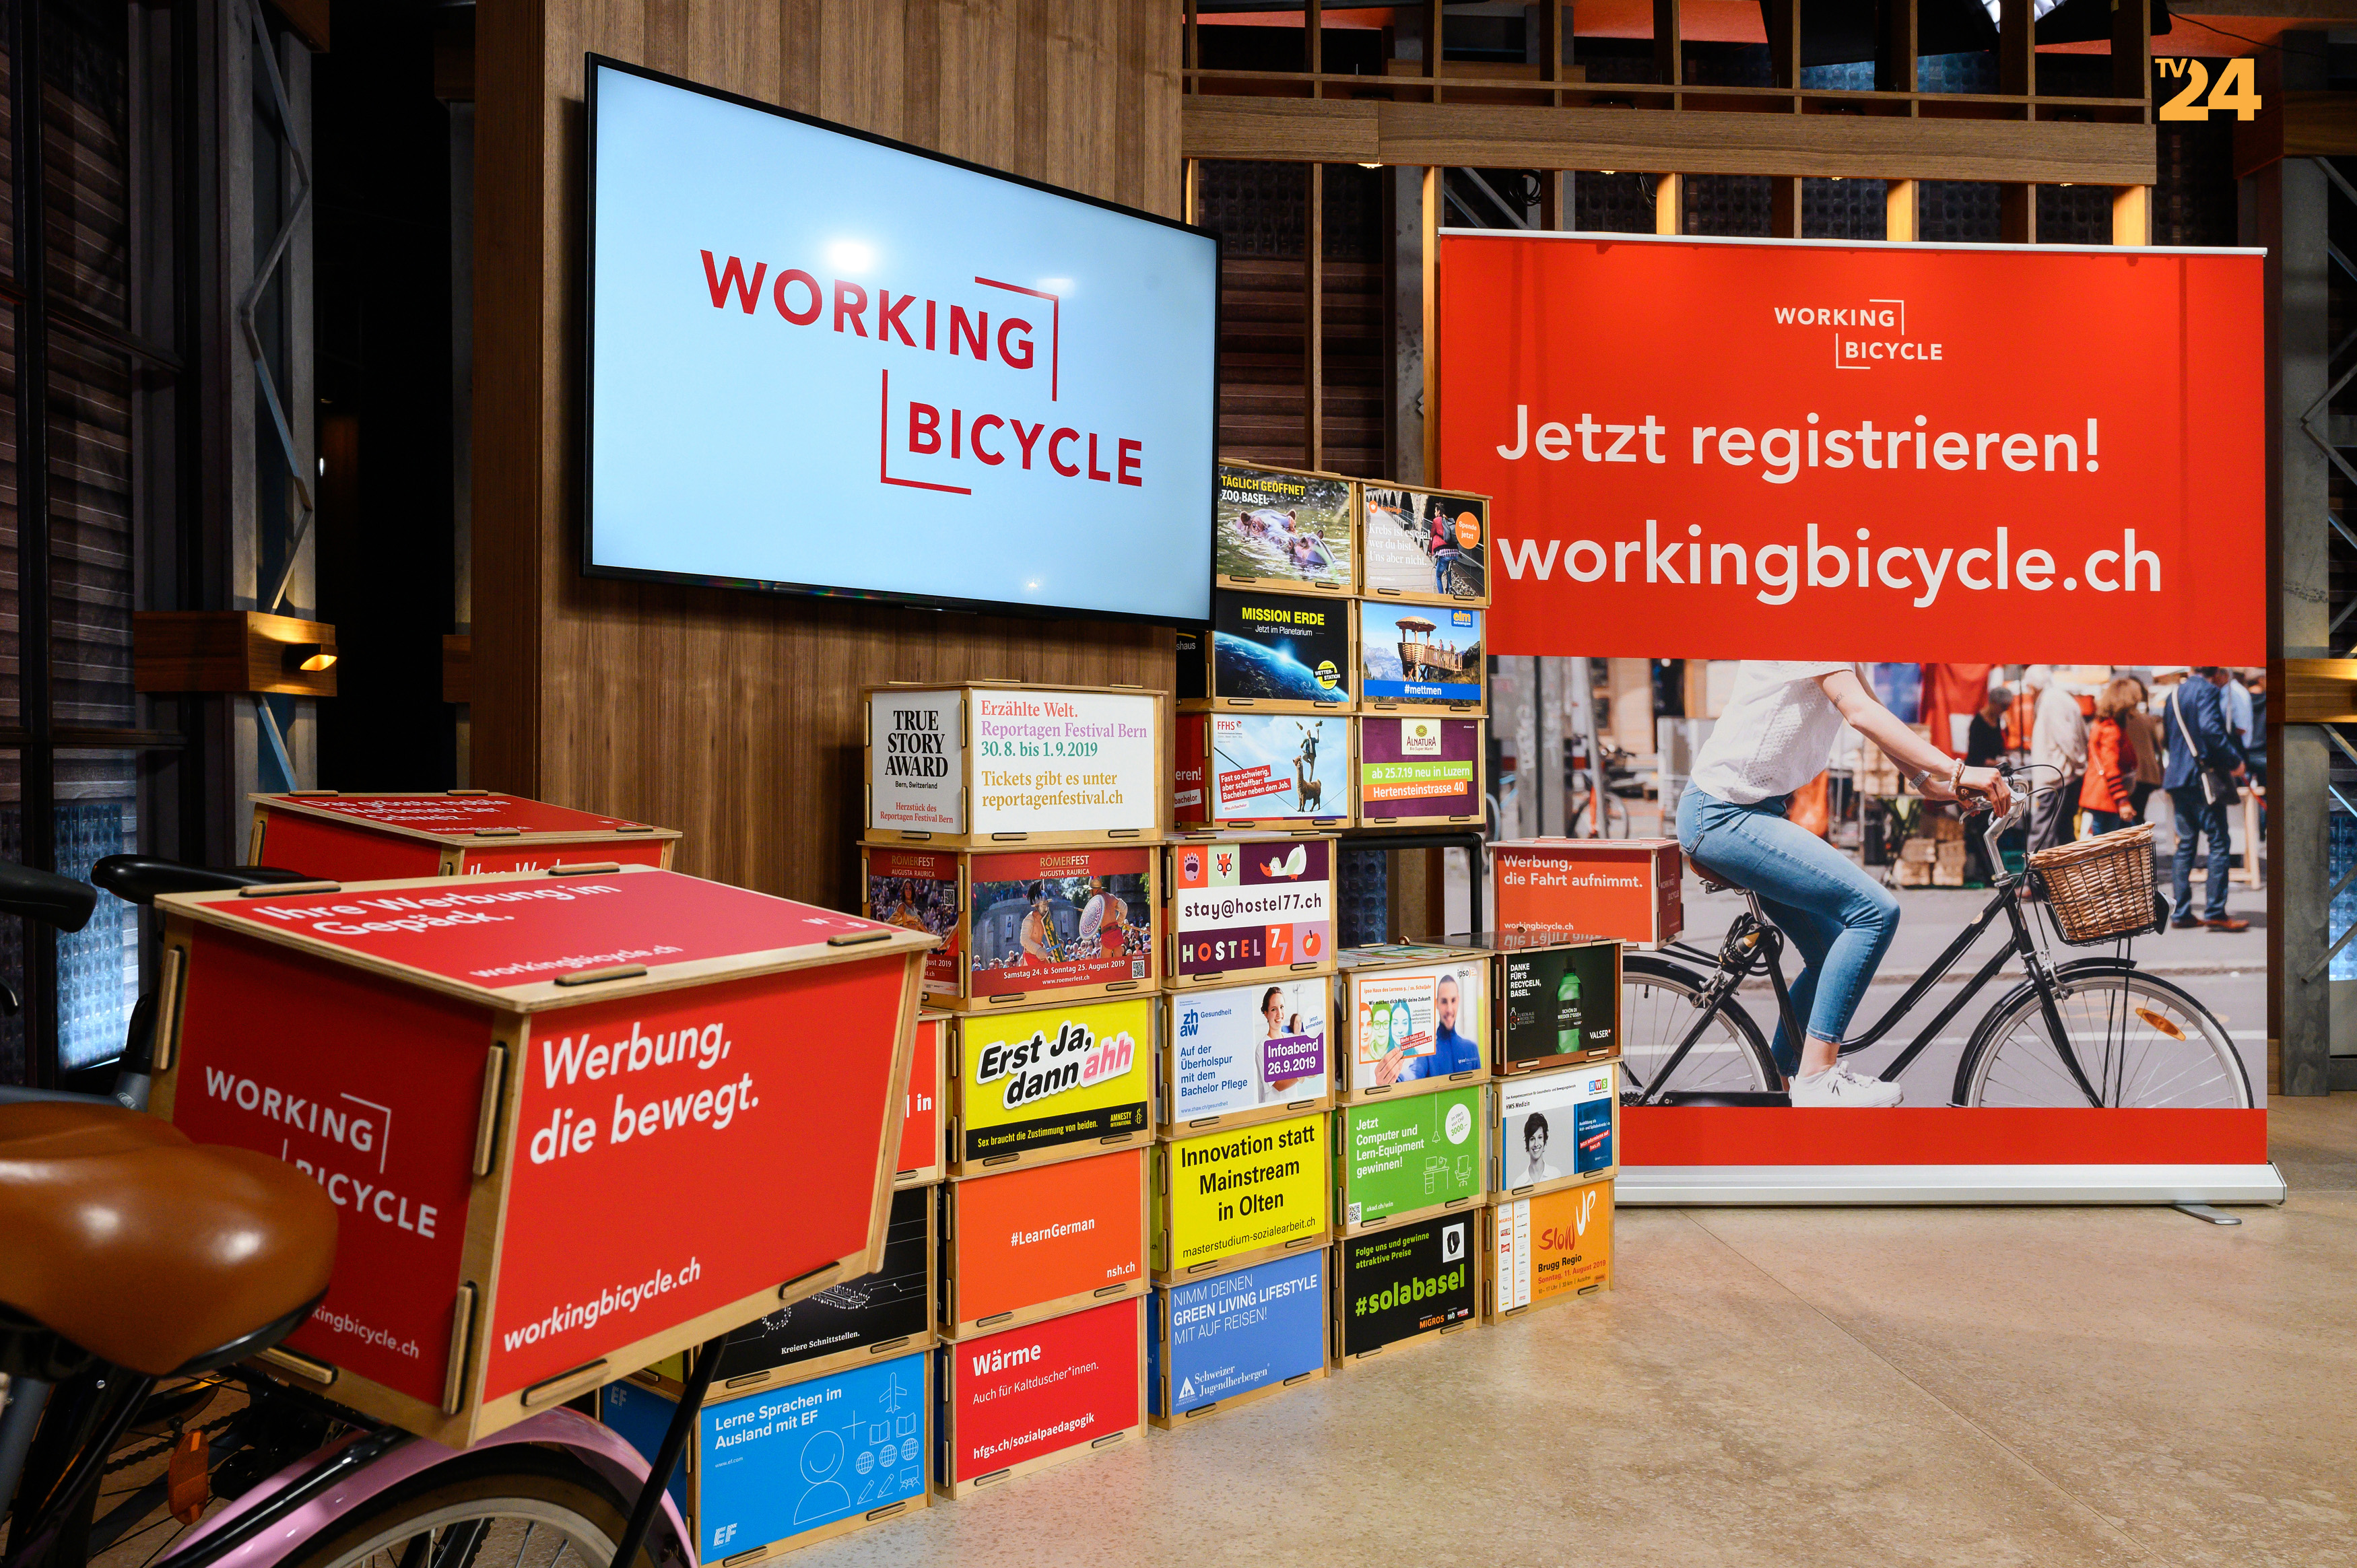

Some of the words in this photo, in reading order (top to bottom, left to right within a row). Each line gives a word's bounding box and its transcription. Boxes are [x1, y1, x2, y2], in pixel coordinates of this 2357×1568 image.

[700, 249, 1034, 370] WORKING
[1774, 308, 1894, 327] WORKING
[1846, 342, 1942, 360] BICYCLE
[909, 401, 1142, 487] BICYCLE
[1496, 404, 1665, 464] Jetzt
[1692, 412, 2100, 485] registrieren!
[1222, 475, 1259, 490] TÄGLICH
[1261, 481, 1305, 496] GEÖFFNET
[1222, 489, 1239, 502] ZOO
[1242, 492, 1268, 504] BASEL
[1459, 521, 1477, 531] Spende
[1461, 531, 1473, 539] jetzt
[1370, 551, 1384, 561] Uns
[1387, 553, 1403, 564] aber
[1406, 555, 1426, 566] nicht.
[1497, 520, 2161, 608] workingbicycle.ch
[1242, 607, 1291, 623] MISSION
[1294, 612, 1325, 625] ERDE
[1453, 611, 1471, 622] elm
[1405, 684, 1442, 695] #mettmen
[981, 700, 1040, 718] Erzählte
[1043, 702, 1077, 718] Welt.
[893, 710, 939, 731] TRUE
[1218, 721, 1234, 730] FFHS
[981, 720, 1061, 741] Reportagen
[1064, 722, 1115, 738] Festival
[1117, 723, 1148, 739] Bern
[888, 733, 945, 754] STORY
[1407, 737, 1436, 746] ALNATURA
[885, 756, 948, 778] AWARD
[1221, 774, 1233, 782] Fast
[1241, 768, 1269, 780] schwierig,
[1372, 768, 1383, 779] ab
[1385, 767, 1412, 778] 25.7.19
[1416, 769, 1430, 777] neu
[1433, 766, 1440, 776] in
[1444, 767, 1469, 776] Luzern
[1222, 782, 1235, 791] aber
[1236, 779, 1263, 789] schaffbar:
[1373, 784, 1451, 798] Hertensteinstrasse
[1454, 782, 1463, 792] 40
[982, 790, 1123, 811] reportagenfestival.ch
[892, 855, 935, 867] RÖMERFEST
[1040, 856, 1090, 867] RÖMERFEST
[1504, 855, 1572, 872] Werbung,
[1504, 873, 1525, 885] die
[1531, 874, 1567, 886] Fahrt
[1572, 875, 1642, 887] aufnimmt.
[254, 903, 357, 921] Ihre
[360, 889, 562, 912] Werbung
[561, 882, 621, 897] im
[1185, 893, 1321, 920] stay@hostel77.ch
[312, 910, 514, 935] Gepäck.
[1183, 939, 1260, 963] HOSTEL
[470, 943, 683, 979] workingbicycle.ch
[1511, 963, 1529, 972] DANKE
[1003, 970, 1030, 980] Samstag
[1051, 965, 1076, 974] Sonntag
[1077, 963, 1087, 971] 25.
[1088, 962, 1109, 971] August
[1042, 974, 1090, 985] www.roemerfest.ch
[1457, 969, 1469, 979] ipso
[1511, 980, 1541, 988] RECYCELN,
[1511, 989, 1530, 997] BASEL.
[1201, 1009, 1232, 1019] Gesundheit
[1306, 1020, 1323, 1029] anmelden
[1590, 1030, 1608, 1039] VALSER
[543, 1022, 732, 1089] Werbung,
[979, 1034, 1043, 1081] Erst
[1049, 1025, 1092, 1057] Ja,
[1268, 1039, 1319, 1058] Infoabend
[1006, 1062, 1079, 1104] dann
[1082, 1036, 1132, 1081] ahh
[1181, 1055, 1232, 1070] Überholspur
[1267, 1056, 1316, 1075] 26.9.2019
[1181, 1083, 1218, 1097] Bachelor
[1222, 1080, 1247, 1091] Pflege
[206, 1066, 374, 1152] WORKING
[1110, 1112, 1132, 1122] AMNESTY
[1181, 1101, 1228, 1114] www.zhaw.ch/gesundheit
[530, 1107, 597, 1164] die
[610, 1072, 760, 1145] bewegt.
[1110, 1120, 1131, 1128] INTERNATIONAL
[1356, 1117, 1379, 1130] Jetzt
[978, 1138, 989, 1148] Sex
[991, 1133, 1015, 1145] braucht
[1016, 1132, 1026, 1142] die
[1028, 1125, 1064, 1140] Zustimmung
[1065, 1124, 1075, 1133] von
[1077, 1120, 1098, 1131] beiden.
[1356, 1129, 1398, 1146] Computer
[1401, 1124, 1418, 1136] und
[1181, 1134, 1273, 1167] Innovation
[1279, 1125, 1315, 1149] statt
[1357, 1138, 1424, 1161] Lern-Equipment
[1357, 1157, 1403, 1178] gewinnen!
[1200, 1161, 1300, 1195] Mainstream
[1219, 1202, 1233, 1222] in
[1240, 1193, 1284, 1216] Olten
[1366, 1201, 1393, 1212] akad.ch/win
[1011, 1219, 1095, 1247] #LearnGerman
[1183, 1217, 1315, 1258] masterstudium-sozialearbeit.ch
[1356, 1255, 1390, 1269] attraktive
[1392, 1248, 1412, 1261] Preise
[1538, 1261, 1559, 1272] Brugg
[1562, 1254, 1581, 1266] Regio
[1106, 1262, 1135, 1278] nsh.ch
[1174, 1286, 1207, 1307] NIMM
[1211, 1274, 1253, 1298] DEINEN
[1356, 1264, 1465, 1316] #solabasel
[504, 1257, 700, 1351] workingbicycle.ch
[1174, 1302, 1216, 1326] GREEN
[1219, 1291, 1256, 1315] LIVING
[1259, 1274, 1317, 1303] LIFESTYLE
[1175, 1326, 1195, 1345] MIT
[1198, 1320, 1220, 1339] AUF
[1224, 1306, 1267, 1332] REISEN!
[1420, 1315, 1444, 1329] MIGROS
[781, 1342, 807, 1355] Kreiere
[809, 1331, 860, 1348] Schnittstellen.
[973, 1344, 1041, 1376] Wärme
[1195, 1365, 1235, 1384] Schweizer
[1199, 1368, 1267, 1397] Jugendherbergen
[973, 1389, 997, 1404] Auch
[999, 1385, 1012, 1398] für
[715, 1410, 755, 1431] Lerne
[759, 1393, 823, 1419] Sprachen
[826, 1389, 842, 1402] im
[715, 1426, 772, 1450] Ausland
[776, 1420, 798, 1438] mit
[801, 1410, 818, 1426] EF
[973, 1412, 1094, 1460] hfgs.ch/sozialpaedagogik
[715, 1457, 743, 1468] www.ef.com
